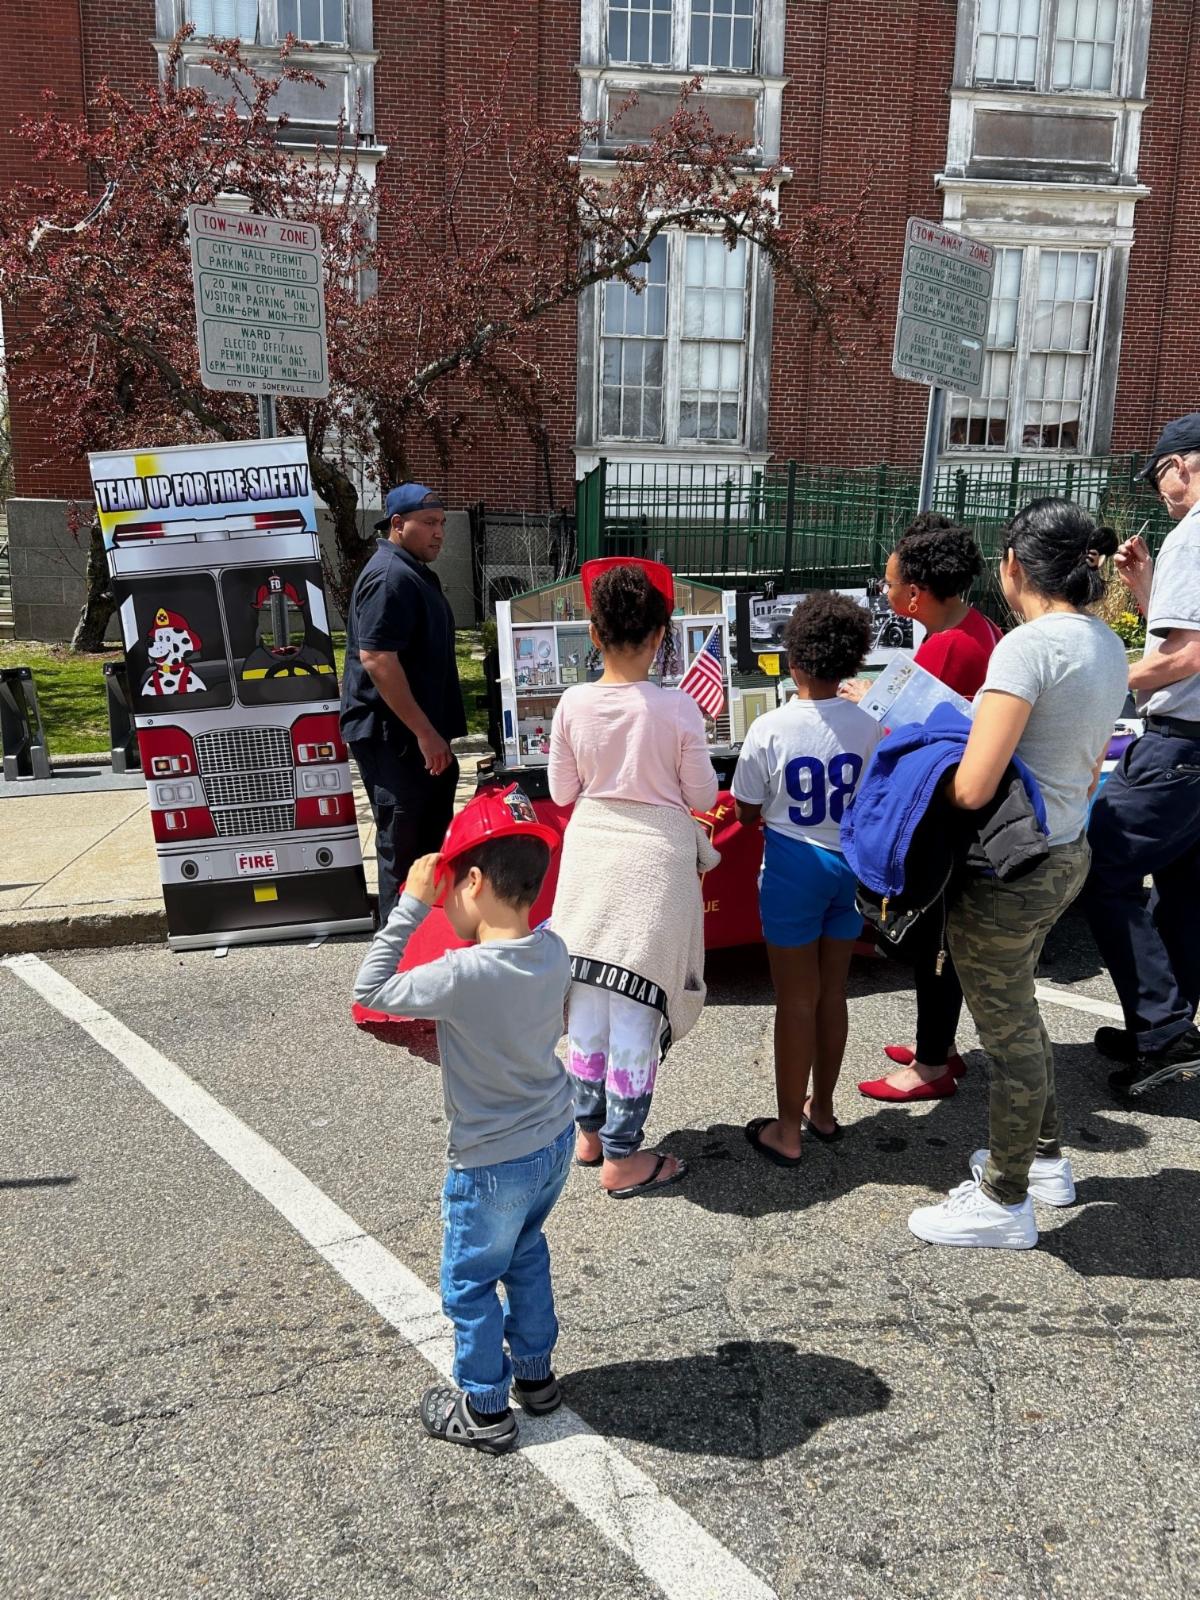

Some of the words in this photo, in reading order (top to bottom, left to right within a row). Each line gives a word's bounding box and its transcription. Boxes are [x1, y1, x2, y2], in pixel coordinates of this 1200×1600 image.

[203, 215, 267, 238] TOW-AWAY
[280, 228, 309, 245] ZONE
[212, 243, 233, 256] CITY
[241, 248, 265, 261] HALL
[270, 253, 303, 266] PERMIT
[916, 226, 963, 252] TOW-AWAY
[969, 245, 990, 263] ZONE
[209, 256, 249, 272] PARKING
[255, 263, 308, 280] PROHIBITED
[920, 251, 935, 263] CITY
[940, 258, 958, 271] HALL
[960, 264, 982, 280] PERMIT
[213, 278, 225, 289] 20
[231, 281, 248, 292] MIN
[256, 285, 276, 296] CITY
[284, 288, 307, 300] HALL
[915, 262, 945, 280] PARKING
[948, 272, 983, 293] PROHIBITED
[204, 289, 241, 304] VISITOR
[246, 295, 286, 310] PARKING
[293, 301, 316, 313] ONLY
[907, 289, 934, 305] VISITOR
[937, 298, 964, 316] PARKING
[968, 310, 985, 323] ONLY
[914, 281, 924, 292] 20
[928, 286, 941, 297] MIN
[945, 290, 960, 303] CITY
[964, 298, 980, 311] HALL
[215, 303, 260, 318] 8AM-6PM
[268, 310, 308, 324] MON-FRI
[950, 314, 978, 331] MON-FRI
[223, 337, 257, 350] ELECTED
[263, 342, 304, 356] OFFICIALS
[241, 328, 271, 341] WARD
[279, 332, 285, 342] 7
[914, 333, 939, 348] ELECTED
[942, 340, 971, 358] OFFICIALS
[220, 349, 247, 362] PERMIT
[251, 352, 283, 366] PARKING
[289, 357, 308, 368] ONLY
[910, 343, 931, 357] PERMIT
[933, 349, 955, 364] PARKING
[209, 361, 273, 376] 6PM-MIDNIGHT
[281, 367, 321, 380] MON-FRI
[226, 379, 242, 387] CITY
[262, 382, 305, 393] SOMERVILLE
[94, 477, 147, 513] TEAM
[145, 474, 173, 509] UP
[172, 472, 209, 507] FOR
[206, 469, 249, 504] FIRE
[247, 463, 309, 501] SAFETY
[270, 579, 281, 590] FD
[785, 752, 863, 827] 98
[239, 855, 275, 870] FIRE
[595, 964, 659, 1005] JORDAN
